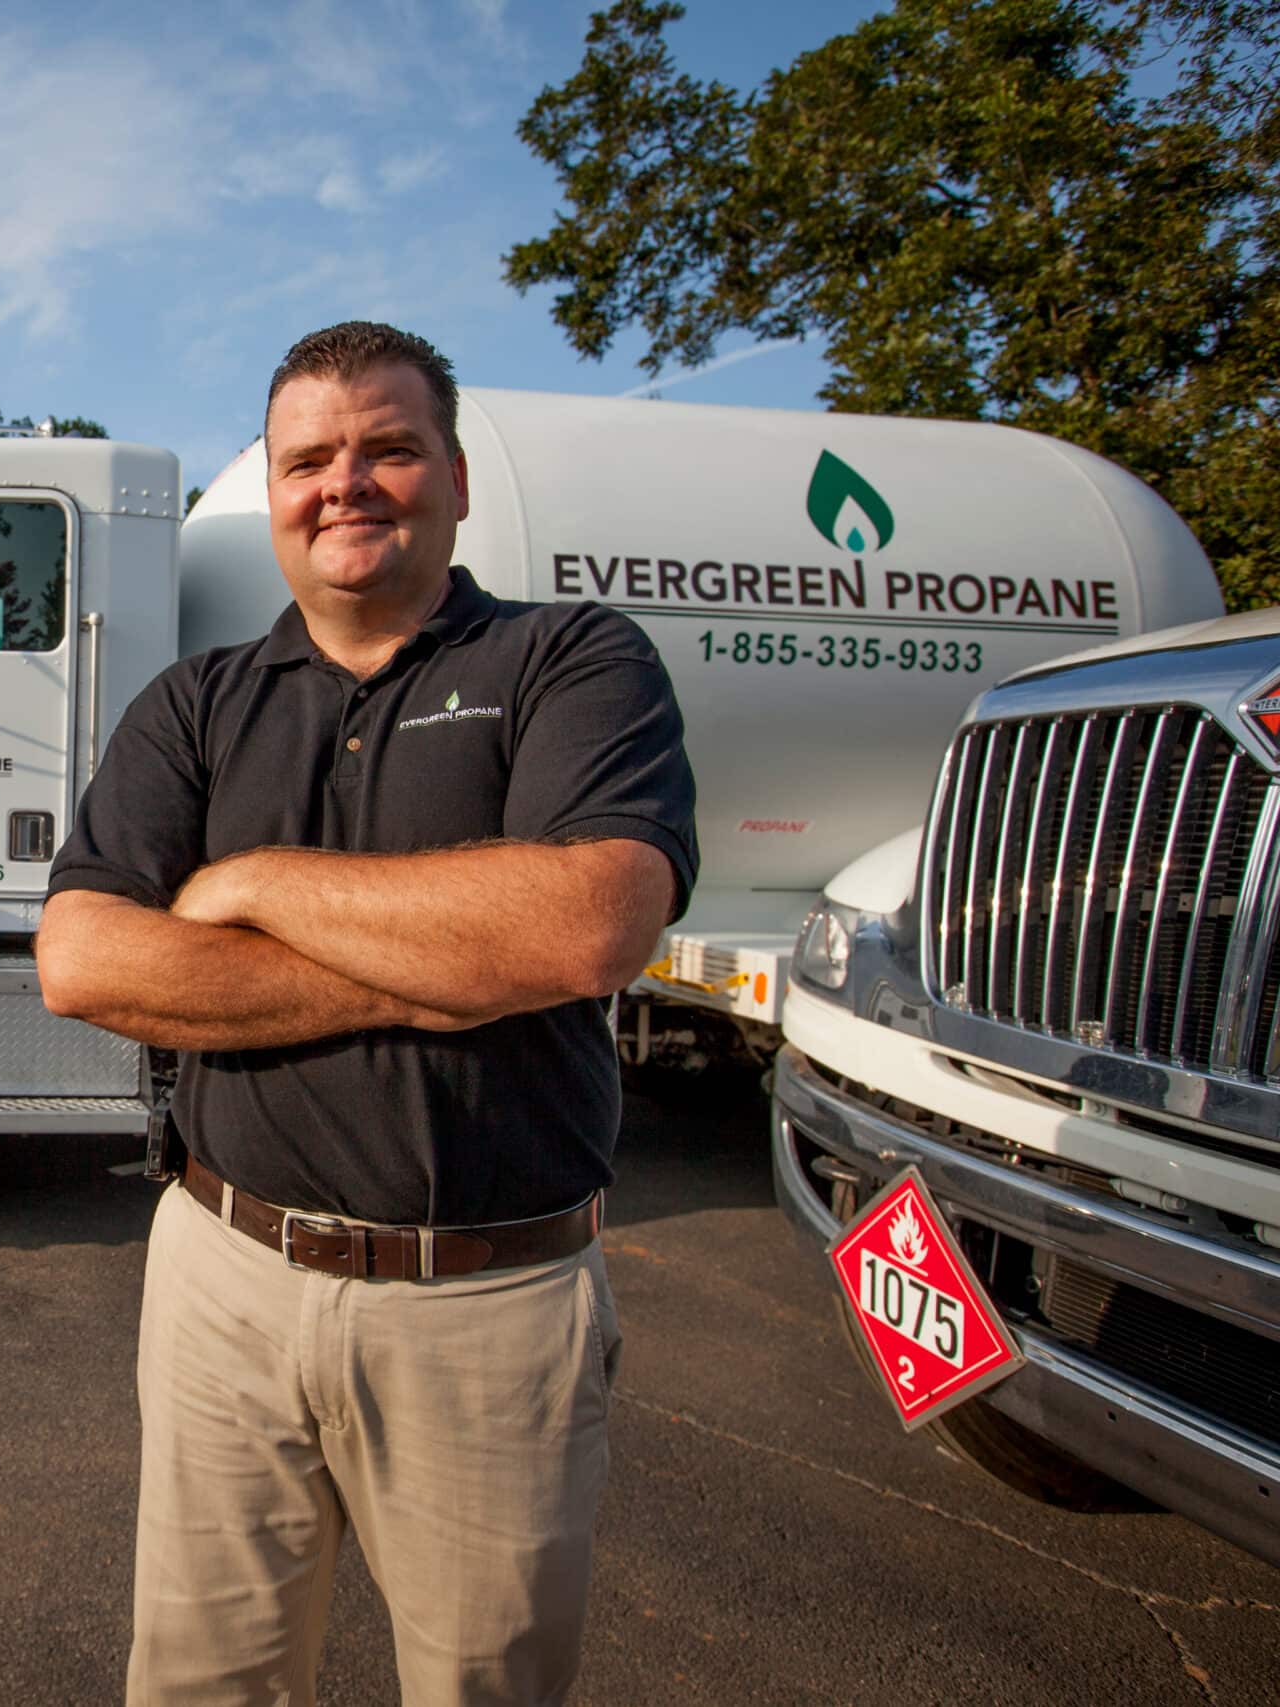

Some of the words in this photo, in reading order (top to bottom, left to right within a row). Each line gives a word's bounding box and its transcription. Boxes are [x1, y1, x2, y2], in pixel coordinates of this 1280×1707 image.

[553, 554, 865, 607] EVERGREEN
[884, 570, 1119, 619] PROPANE
[698, 630, 983, 672] 1-855-335-9333
[400, 711, 453, 728] EVERGREEN
[455, 706, 502, 719] PROPANE
[739, 819, 809, 833] PROPANE
[865, 1258, 959, 1360] 1075
[897, 1355, 915, 1393] 2
